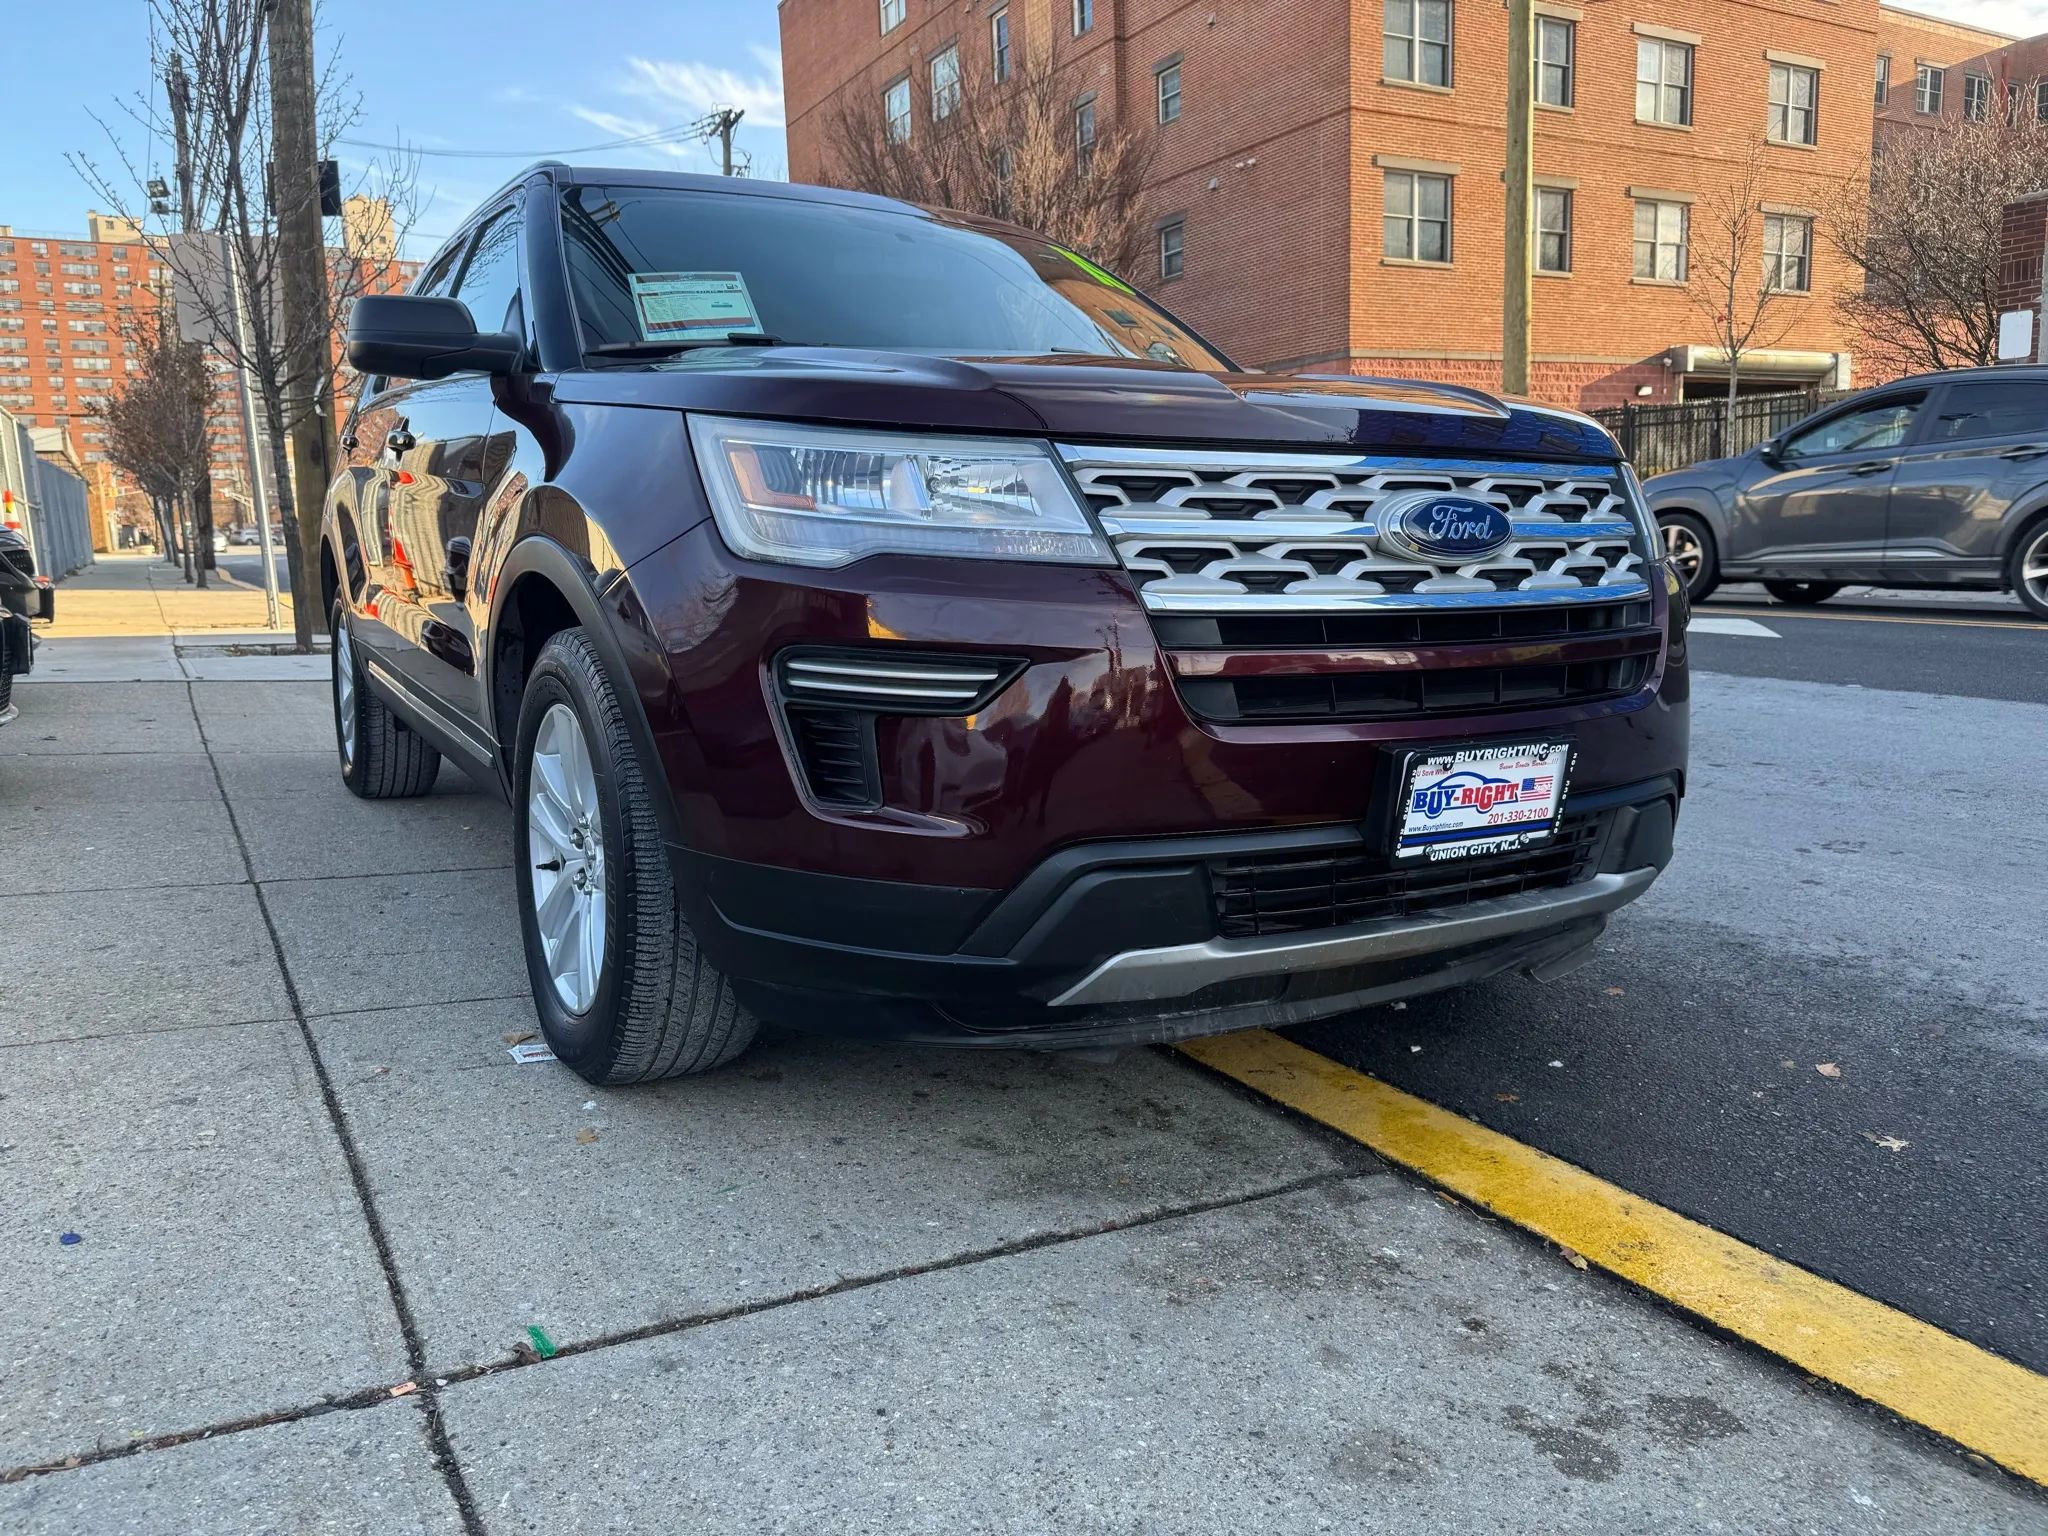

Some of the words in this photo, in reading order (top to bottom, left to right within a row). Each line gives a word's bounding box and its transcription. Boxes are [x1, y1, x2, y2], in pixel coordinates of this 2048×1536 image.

[1428, 505, 1493, 540] Ford
[1569, 752, 1578, 773] 201
[1413, 782, 1520, 815] BUY-RIGHT
[1487, 807, 1549, 825] 201-330-2100
[1430, 845, 1470, 861] UNION
[1470, 841, 1497, 856] CITY,
[1500, 839, 1521, 851] N.J.
